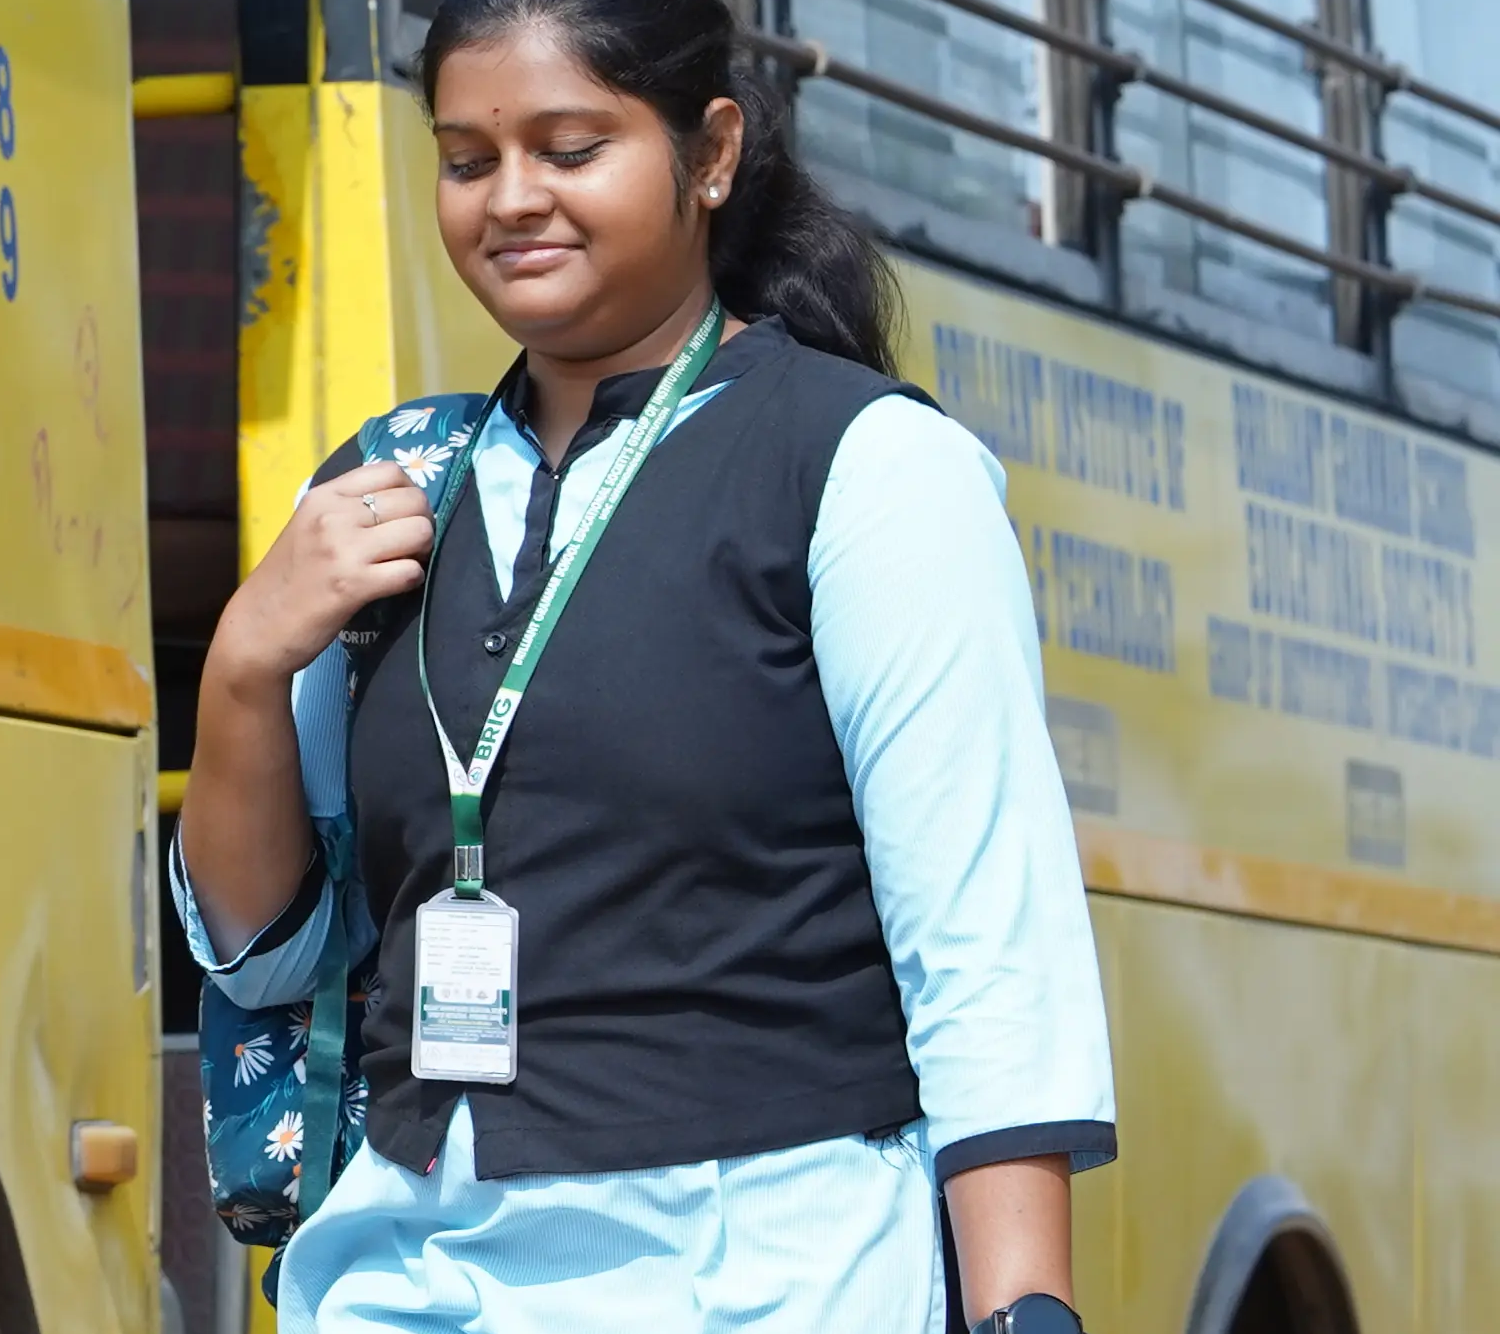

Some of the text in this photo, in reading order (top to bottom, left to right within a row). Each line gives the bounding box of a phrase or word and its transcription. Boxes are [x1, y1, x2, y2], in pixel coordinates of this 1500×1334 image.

[651, 353, 692, 408] INSTITUTIONS
[644, 403, 659, 419] OF
[627, 419, 650, 449] GROUP
[573, 484, 613, 543] EDUCATIONAL
[554, 543, 581, 577] SCHOOL
[533, 577, 562, 622] GRAMMAR
[512, 621, 540, 665] BRILLIANT
[474, 698, 512, 760] BRIG
